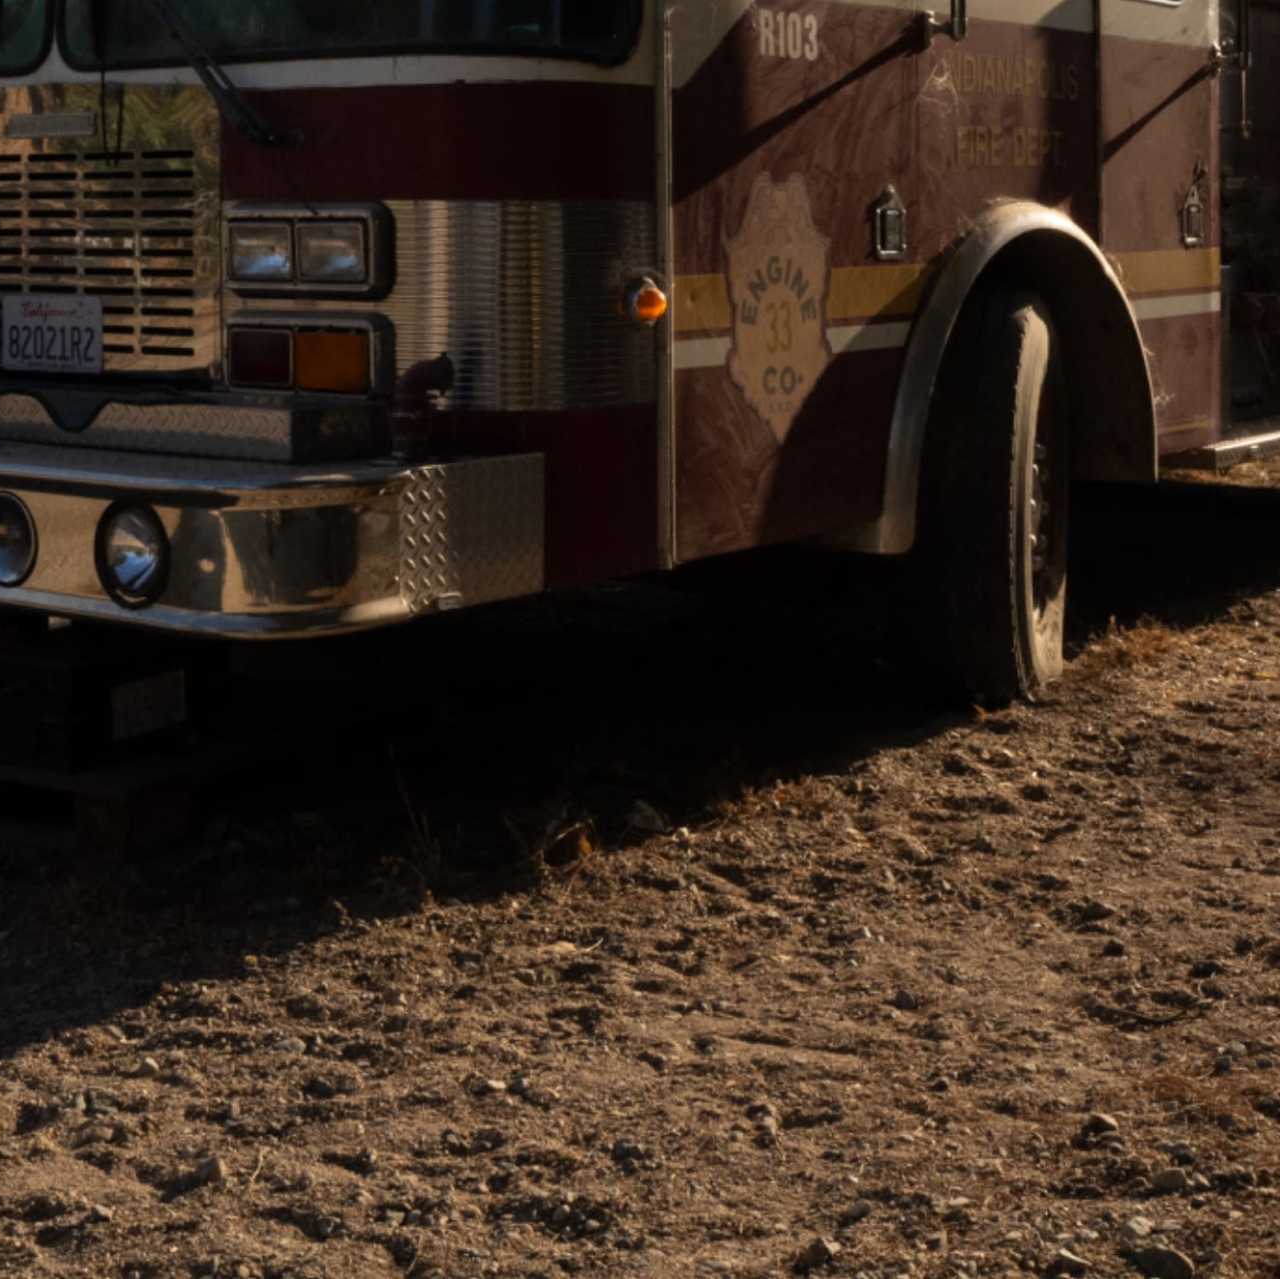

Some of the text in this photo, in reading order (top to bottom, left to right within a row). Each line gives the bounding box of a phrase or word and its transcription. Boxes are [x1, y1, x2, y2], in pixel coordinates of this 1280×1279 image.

[759, 8, 819, 61] R103
[957, 126, 1001, 168] FIRE
[740, 255, 816, 325] ENGINE
[8, 325, 95, 364] 82021R2
[765, 300, 793, 354] 33
